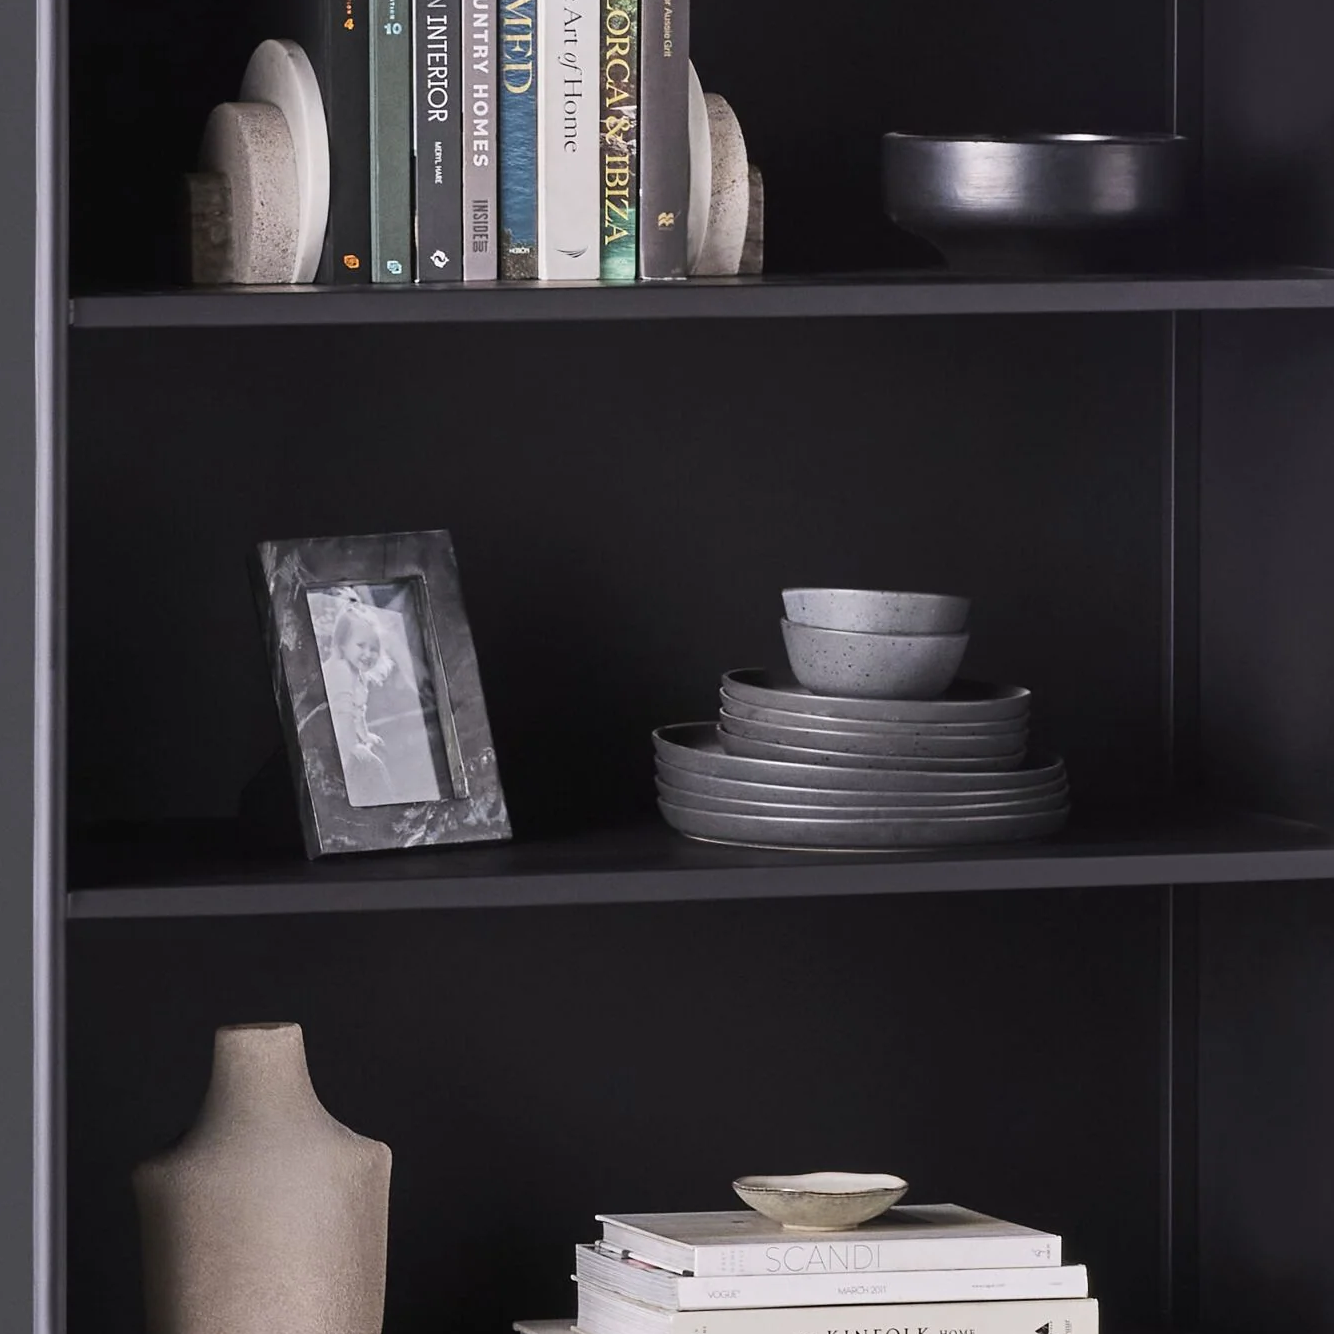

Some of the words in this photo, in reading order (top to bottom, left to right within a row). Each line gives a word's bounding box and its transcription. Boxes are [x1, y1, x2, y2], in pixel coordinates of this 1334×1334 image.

[343, 17, 355, 31] 4
[383, 22, 403, 35] 10
[563, 7, 583, 44] Art
[663, 7, 673, 39] Aussie
[663, 40, 673, 58] Grit
[426, 15, 449, 122] INTERIOR
[558, 52, 582, 76] of
[472, 84, 489, 167] HOMES
[563, 78, 583, 153] Home
[605, 116, 632, 144] &
[434, 141, 443, 164] MERYL
[434, 165, 443, 185] HARE
[604, 153, 630, 246] IBIZA
[472, 199, 489, 240] INSIDE
[765, 1244, 881, 1273] SCANDI
[837, 1286, 869, 1295] MARCH
